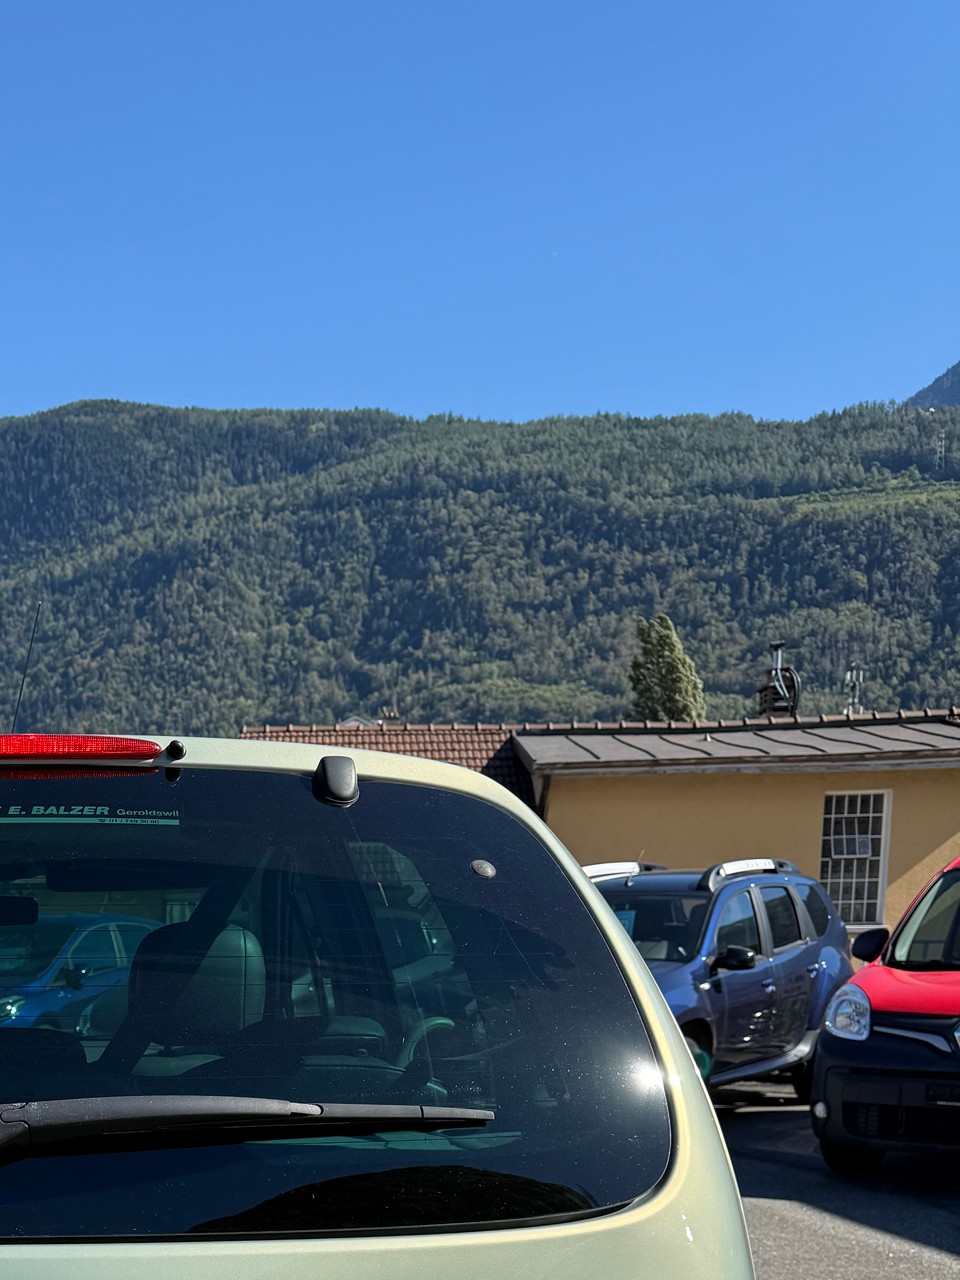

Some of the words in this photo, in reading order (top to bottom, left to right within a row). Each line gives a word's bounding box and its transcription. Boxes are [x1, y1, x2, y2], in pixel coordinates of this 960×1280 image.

[8, 806, 26, 816] E.
[31, 806, 110, 816] BALZER
[116, 808, 179, 817] Geroldswil
